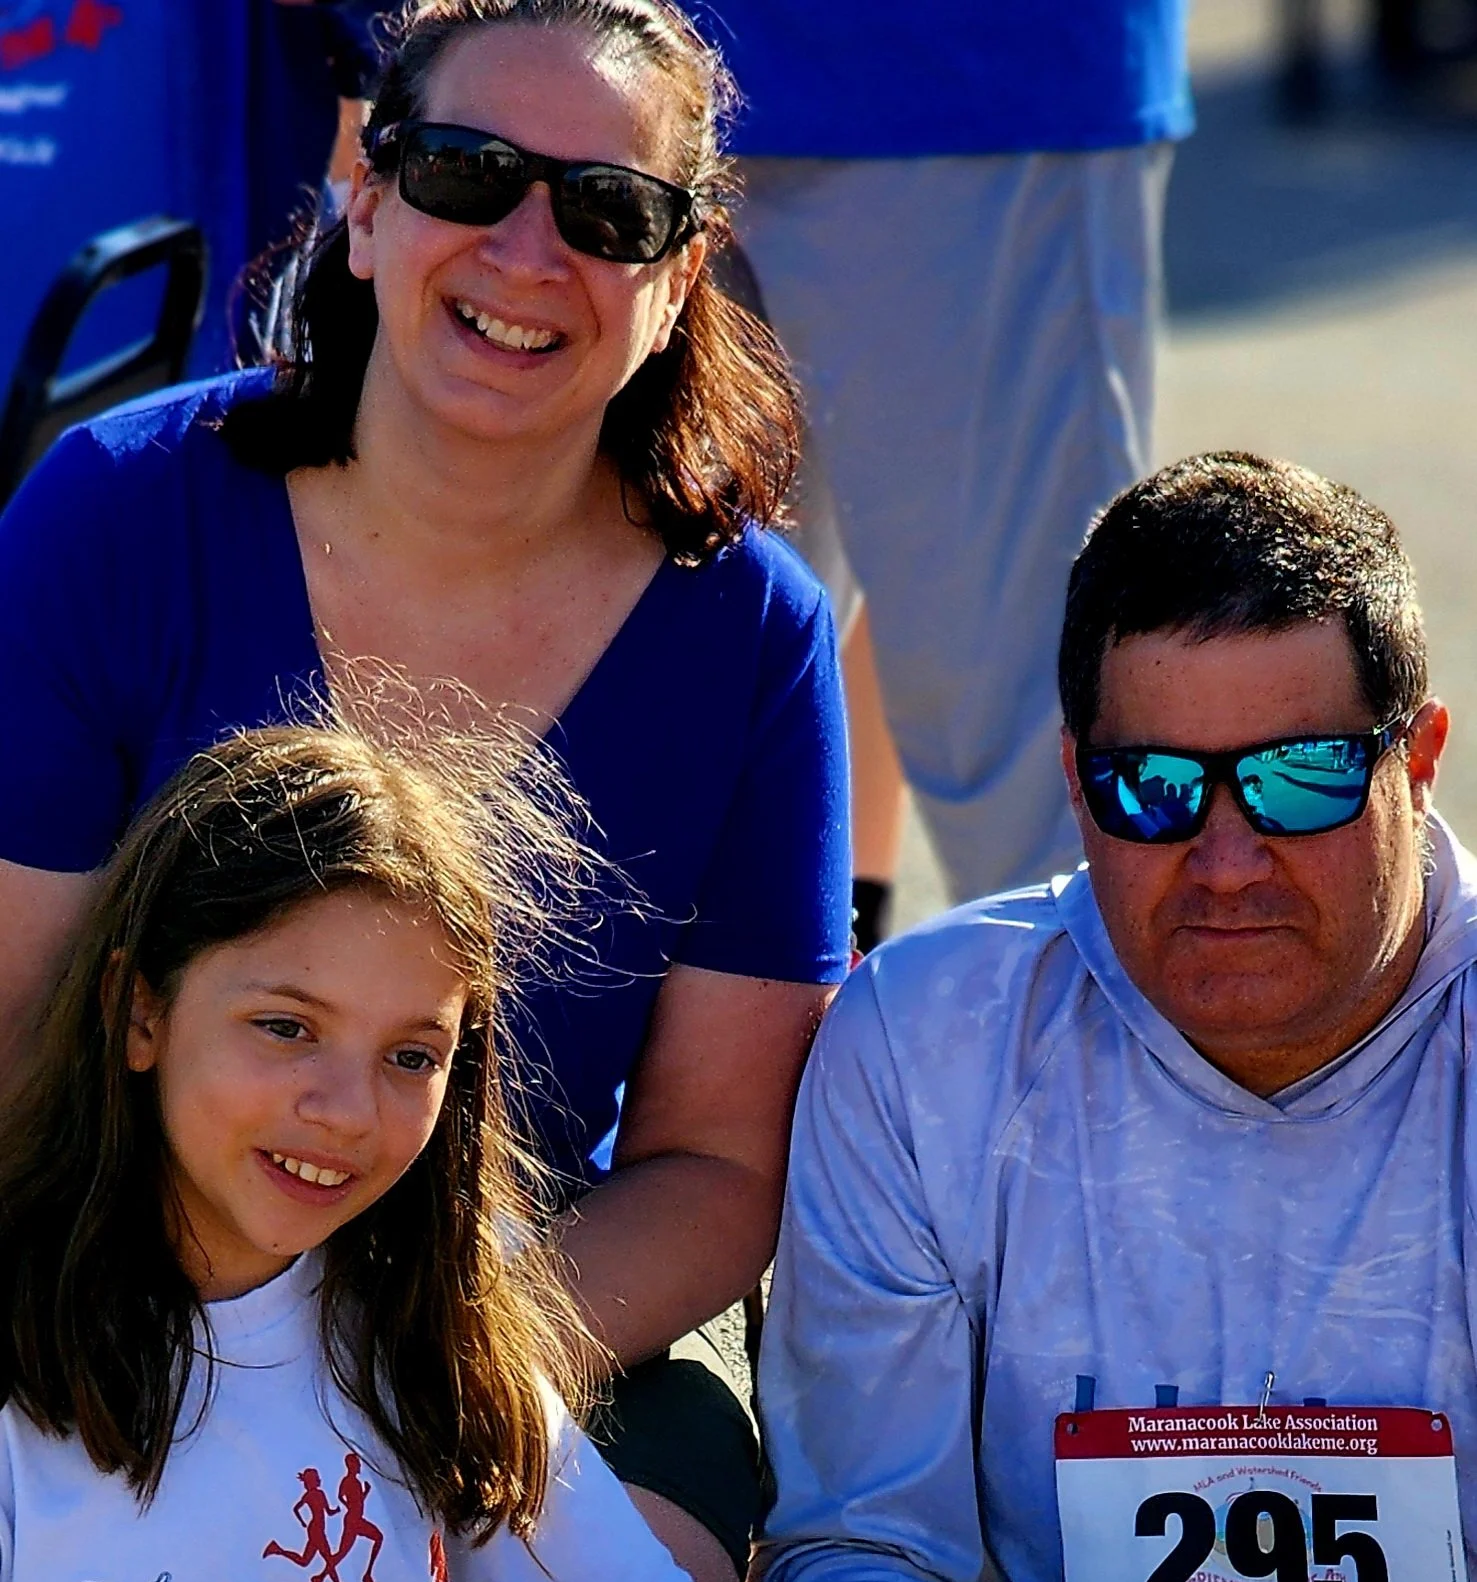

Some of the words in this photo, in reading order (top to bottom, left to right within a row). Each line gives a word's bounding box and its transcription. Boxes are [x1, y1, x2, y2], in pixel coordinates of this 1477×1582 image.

[1128, 1413, 1239, 1433] Maranacook
[1242, 1414, 1281, 1430] Lake
[1284, 1413, 1378, 1432] Association
[1131, 1433, 1378, 1455] www.maranacooklakeme.org
